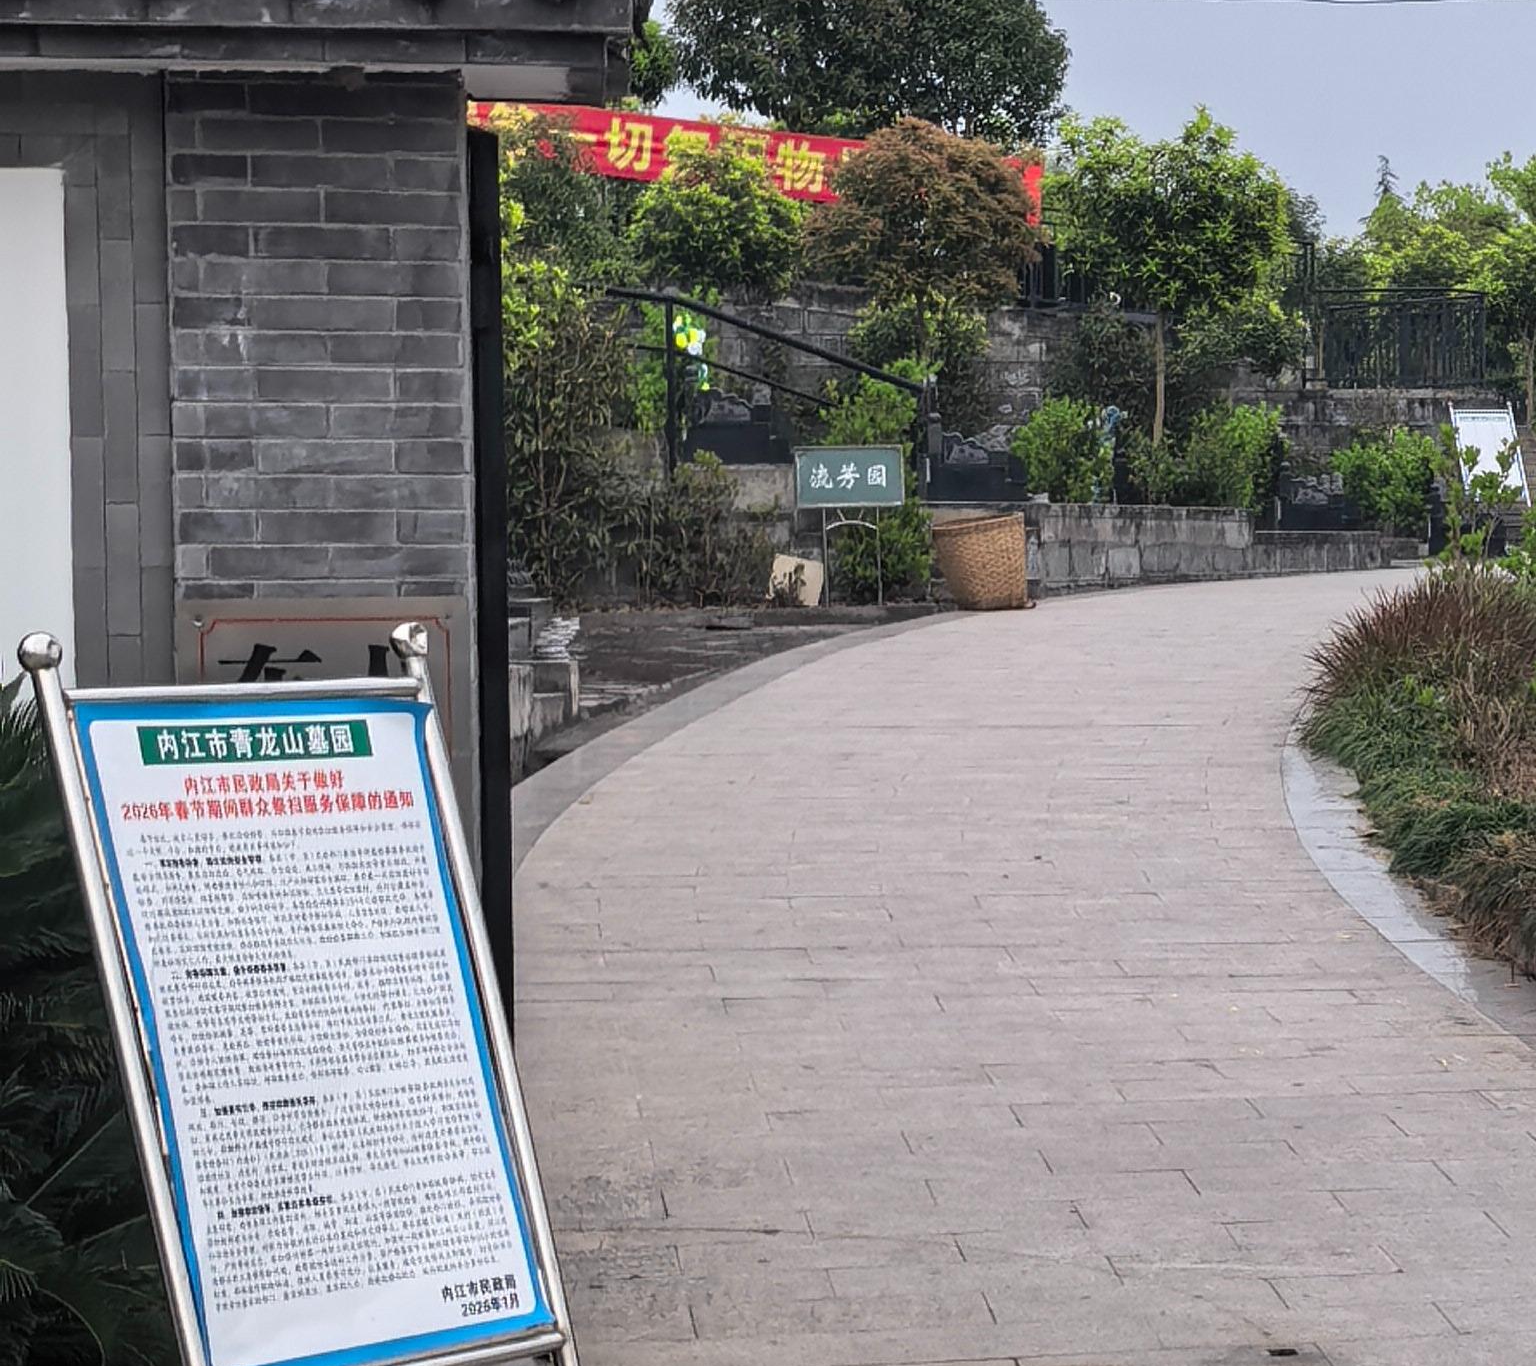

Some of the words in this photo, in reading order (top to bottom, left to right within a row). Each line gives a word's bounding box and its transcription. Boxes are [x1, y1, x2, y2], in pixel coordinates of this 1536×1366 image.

[156, 723, 355, 761] 内江市青龙山墓园
[183, 769, 344, 796] 内江市民政局关于做好
[441, 1274, 517, 1303] 内江市民政局
